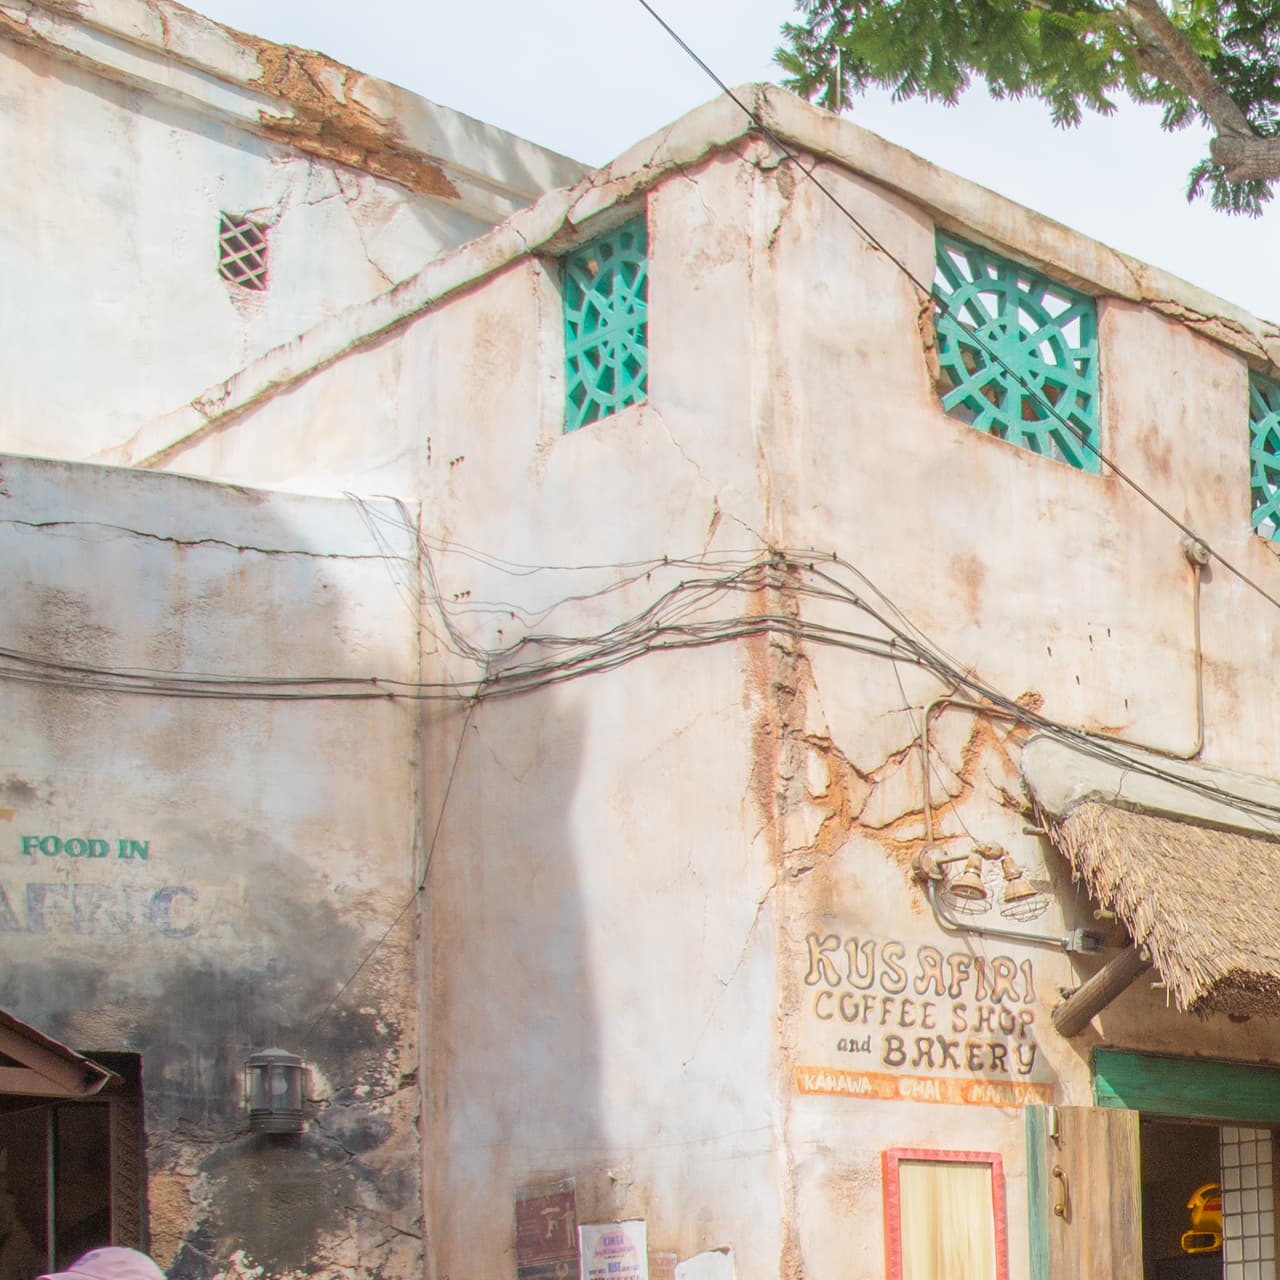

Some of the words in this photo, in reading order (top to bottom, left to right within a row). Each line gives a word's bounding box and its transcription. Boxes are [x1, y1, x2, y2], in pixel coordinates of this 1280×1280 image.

[21, 835, 110, 857] FOOD
[117, 839, 149, 860] IN
[804, 933, 1036, 1005] KUSAFIRI
[815, 991, 937, 1030] COFFEE
[951, 1003, 1036, 1040] SHOP
[837, 1035, 872, 1054] and
[882, 1034, 1037, 1075] BAKERY
